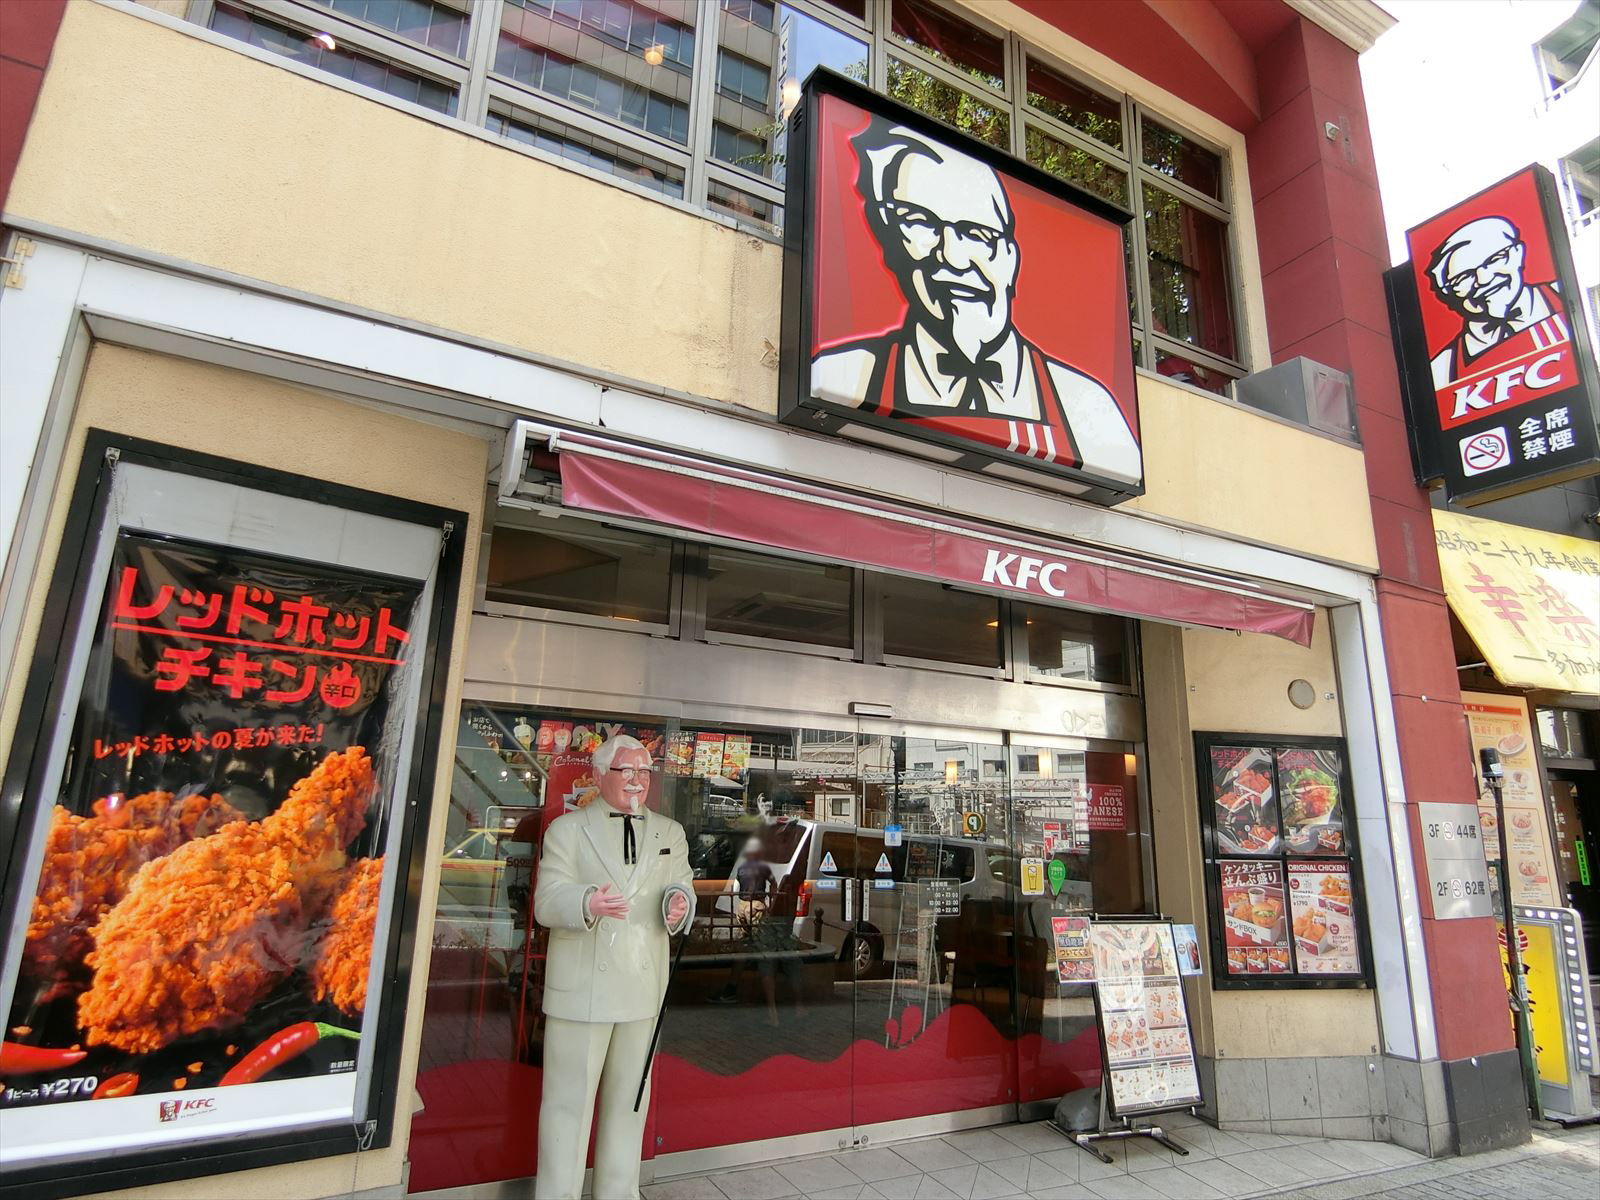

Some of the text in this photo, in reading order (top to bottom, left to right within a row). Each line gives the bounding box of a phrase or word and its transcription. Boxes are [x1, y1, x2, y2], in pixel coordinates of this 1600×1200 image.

[1450, 351, 1561, 419] KFC
[1518, 406, 1569, 439] 全席
[1521, 428, 1575, 460] 禁煙
[981, 549, 1067, 597] KFC
[114, 566, 410, 654] レッドホット
[154, 647, 316, 704] チキン
[324, 682, 358, 699] 辛口
[93, 723, 324, 760] レッドホットの夏が来た!
[1099, 796, 1122, 806] 100%
[1428, 823, 1477, 839] 3F 44席
[1224, 862, 1273, 875] ケンタッキー
[1288, 864, 1346, 872] ORIGINAL CHICKEN
[1223, 871, 1277, 888] ぜんぶ盛り
[1437, 881, 1485, 897] 2F 62席
[7, 1076, 98, 1100] 1ピース ¥270
[184, 1098, 216, 1111] KFC
